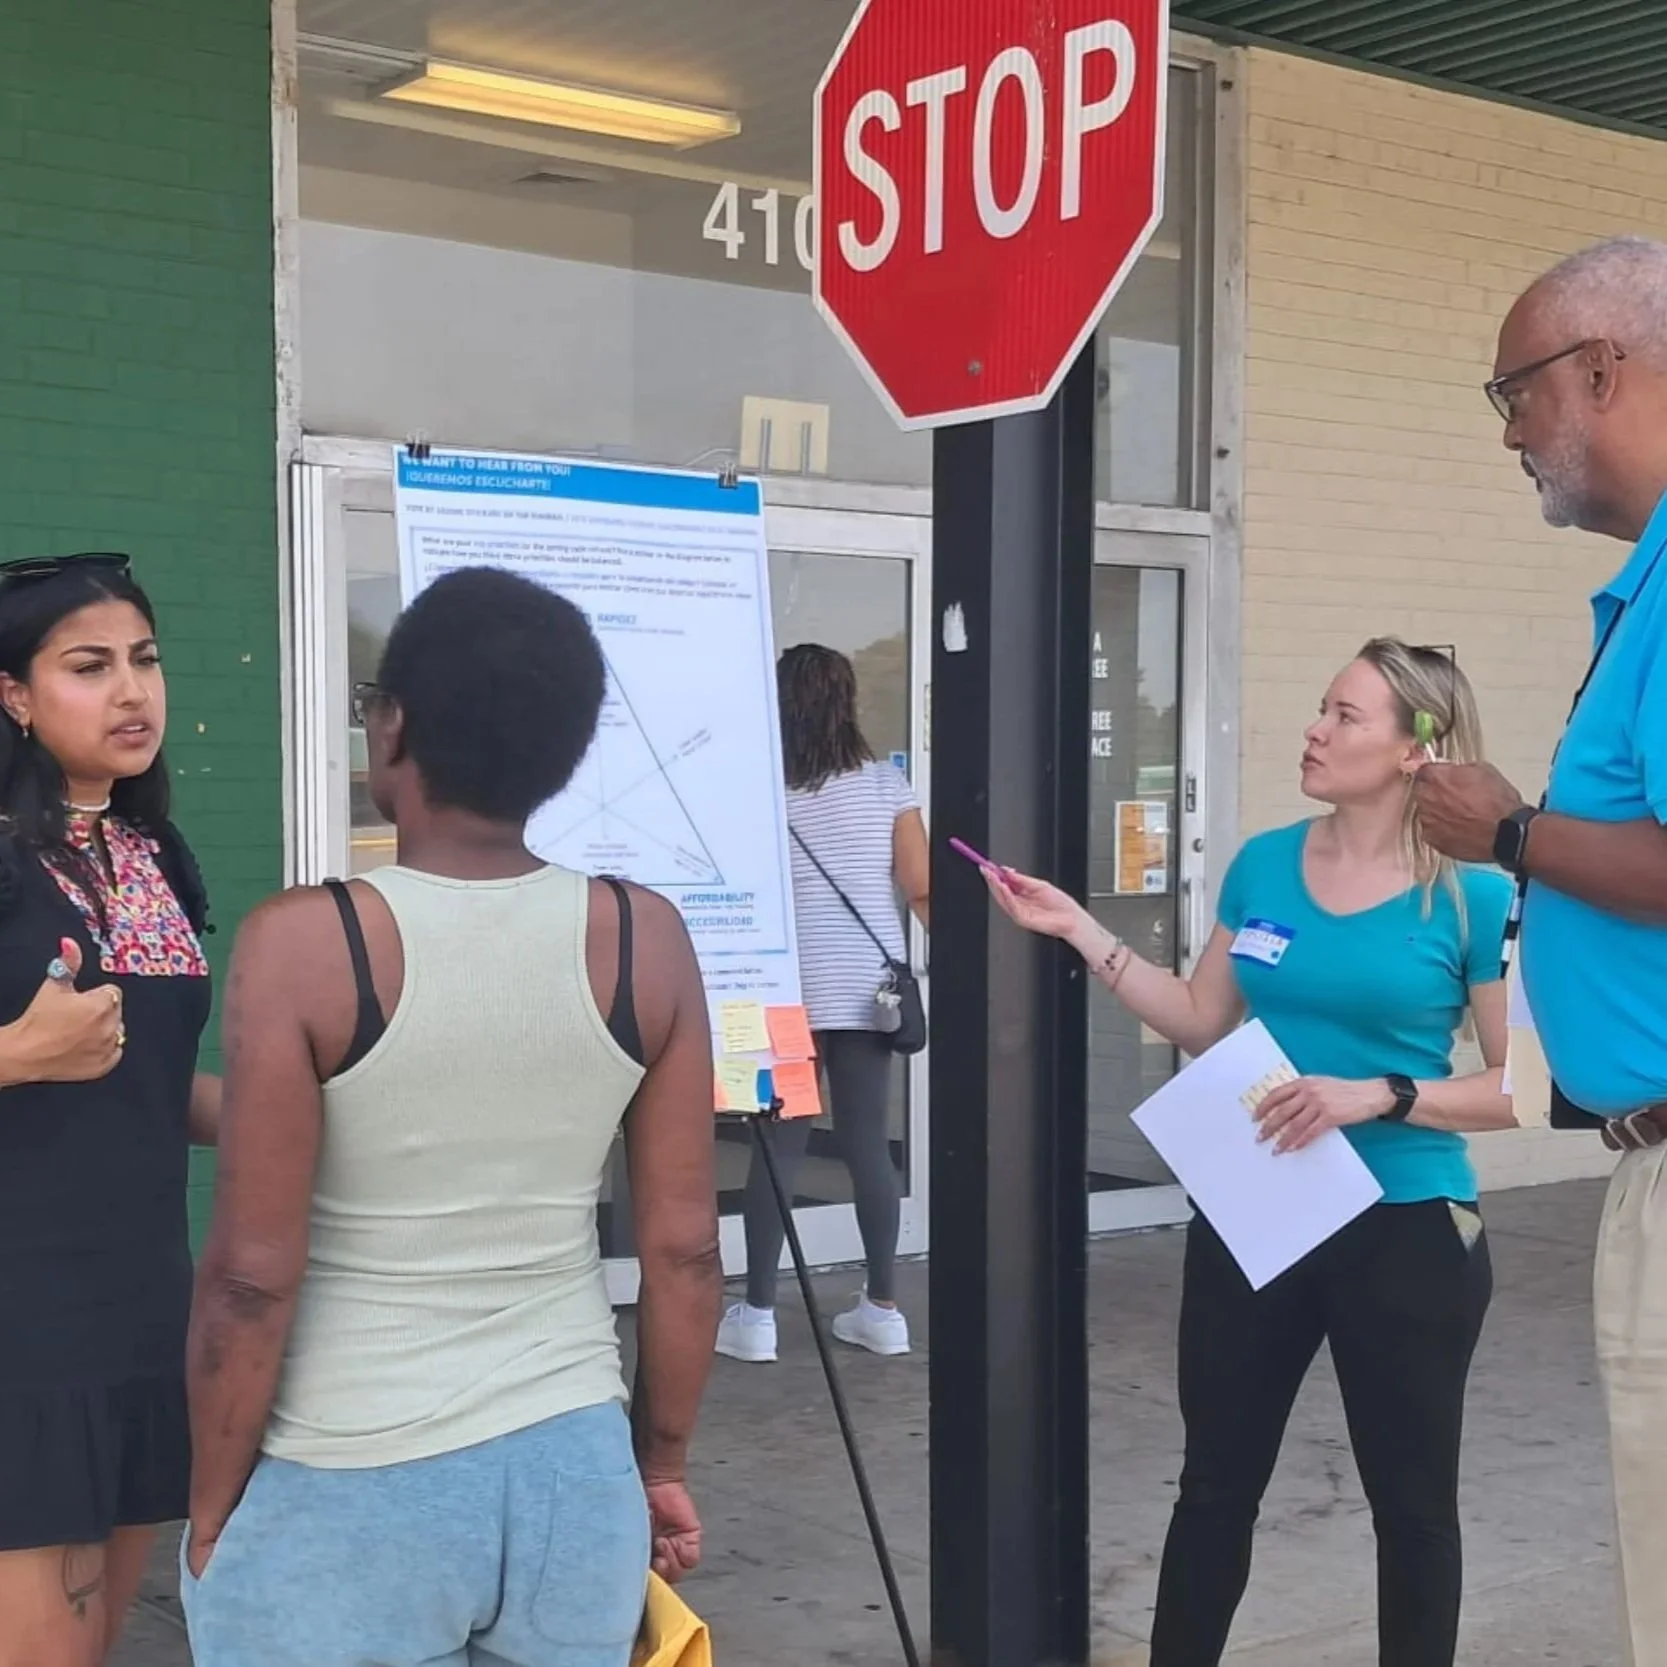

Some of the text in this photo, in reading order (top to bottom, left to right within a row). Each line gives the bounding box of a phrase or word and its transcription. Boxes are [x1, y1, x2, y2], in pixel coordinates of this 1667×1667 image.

[838, 19, 1136, 272] STOP
[423, 457, 455, 469] WANT
[459, 458, 477, 470] TO
[478, 459, 508, 471] HEAR
[510, 461, 543, 474] FROM
[544, 463, 571, 477] YOU!
[681, 892, 755, 904] AFFORDABILITY
